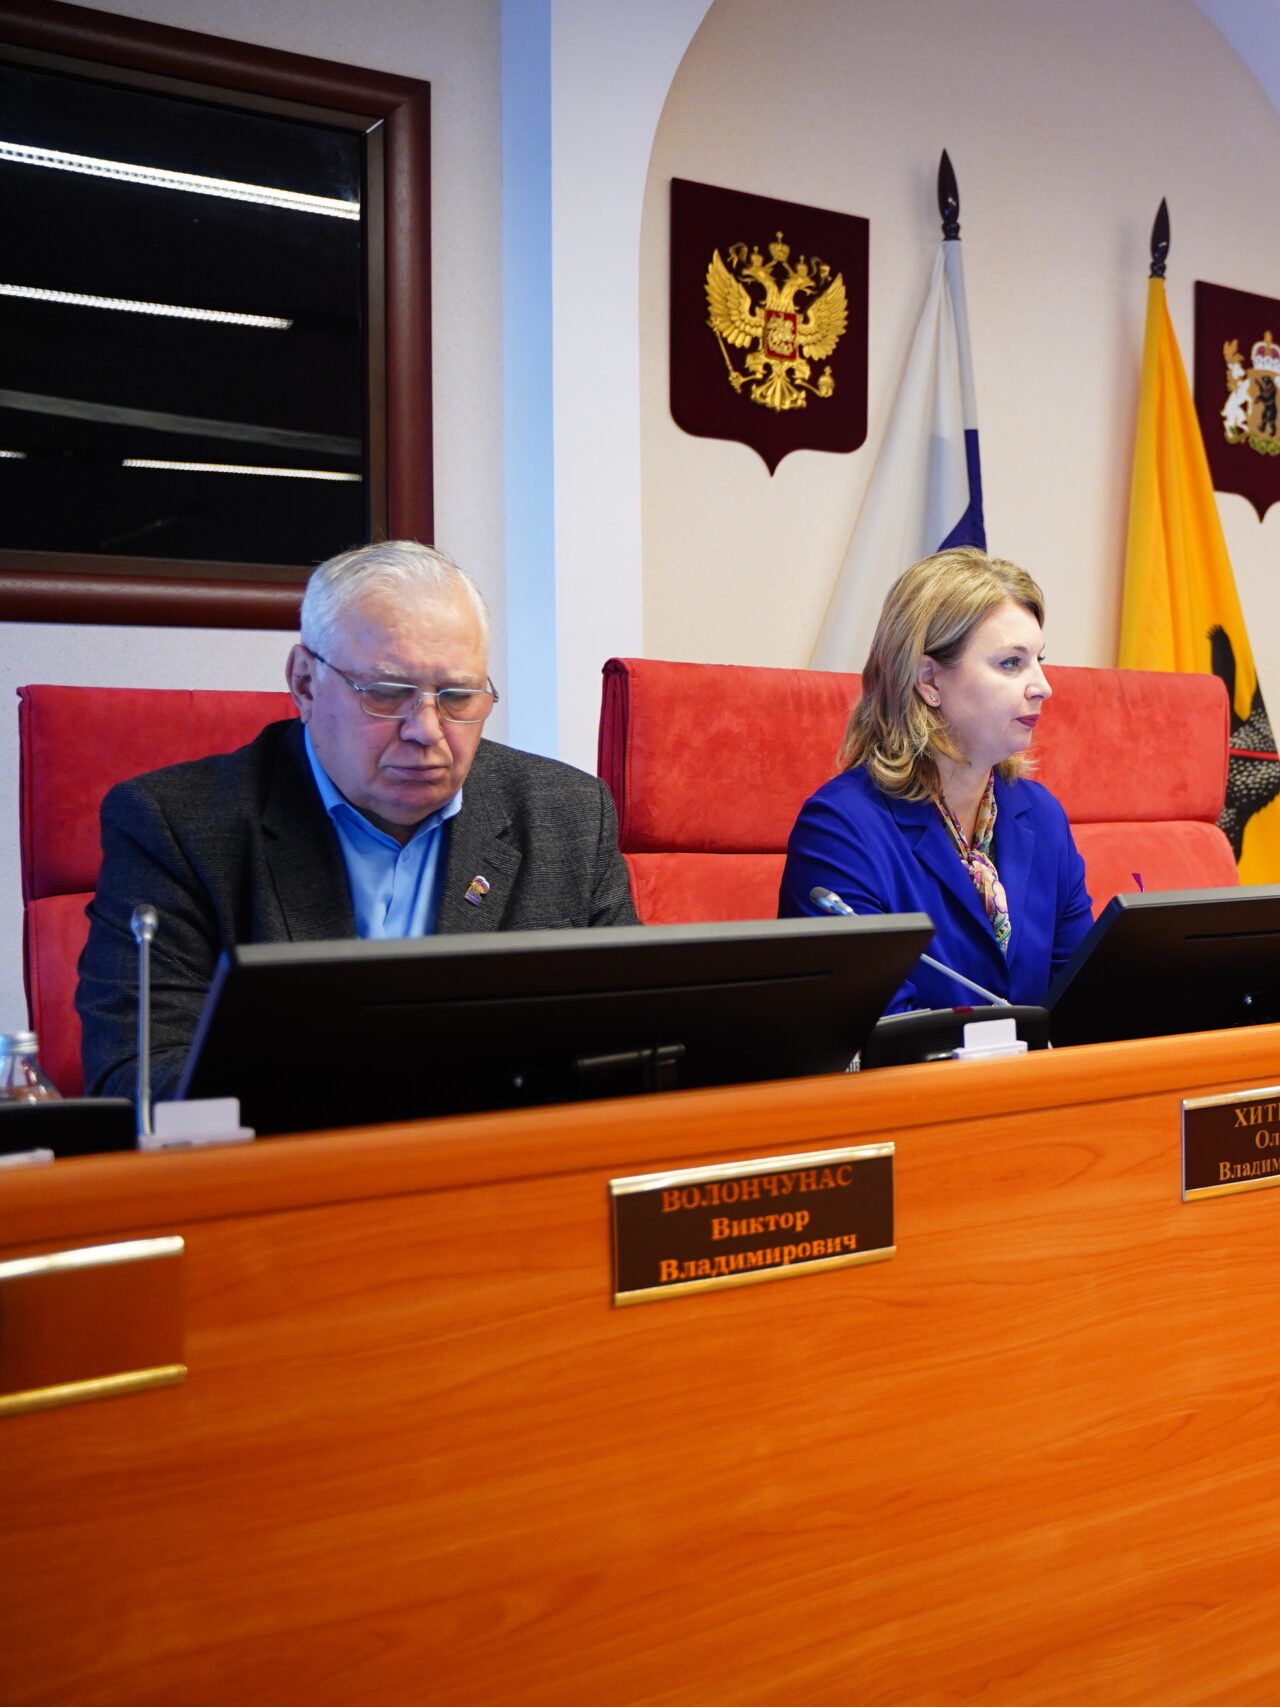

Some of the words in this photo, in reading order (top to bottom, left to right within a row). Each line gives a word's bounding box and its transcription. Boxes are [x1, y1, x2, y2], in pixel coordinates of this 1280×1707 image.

[661, 1165, 854, 1213] ВОЛОНЧУНАС
[710, 1209, 810, 1241] Виктор
[659, 1234, 858, 1282] Владимирович
